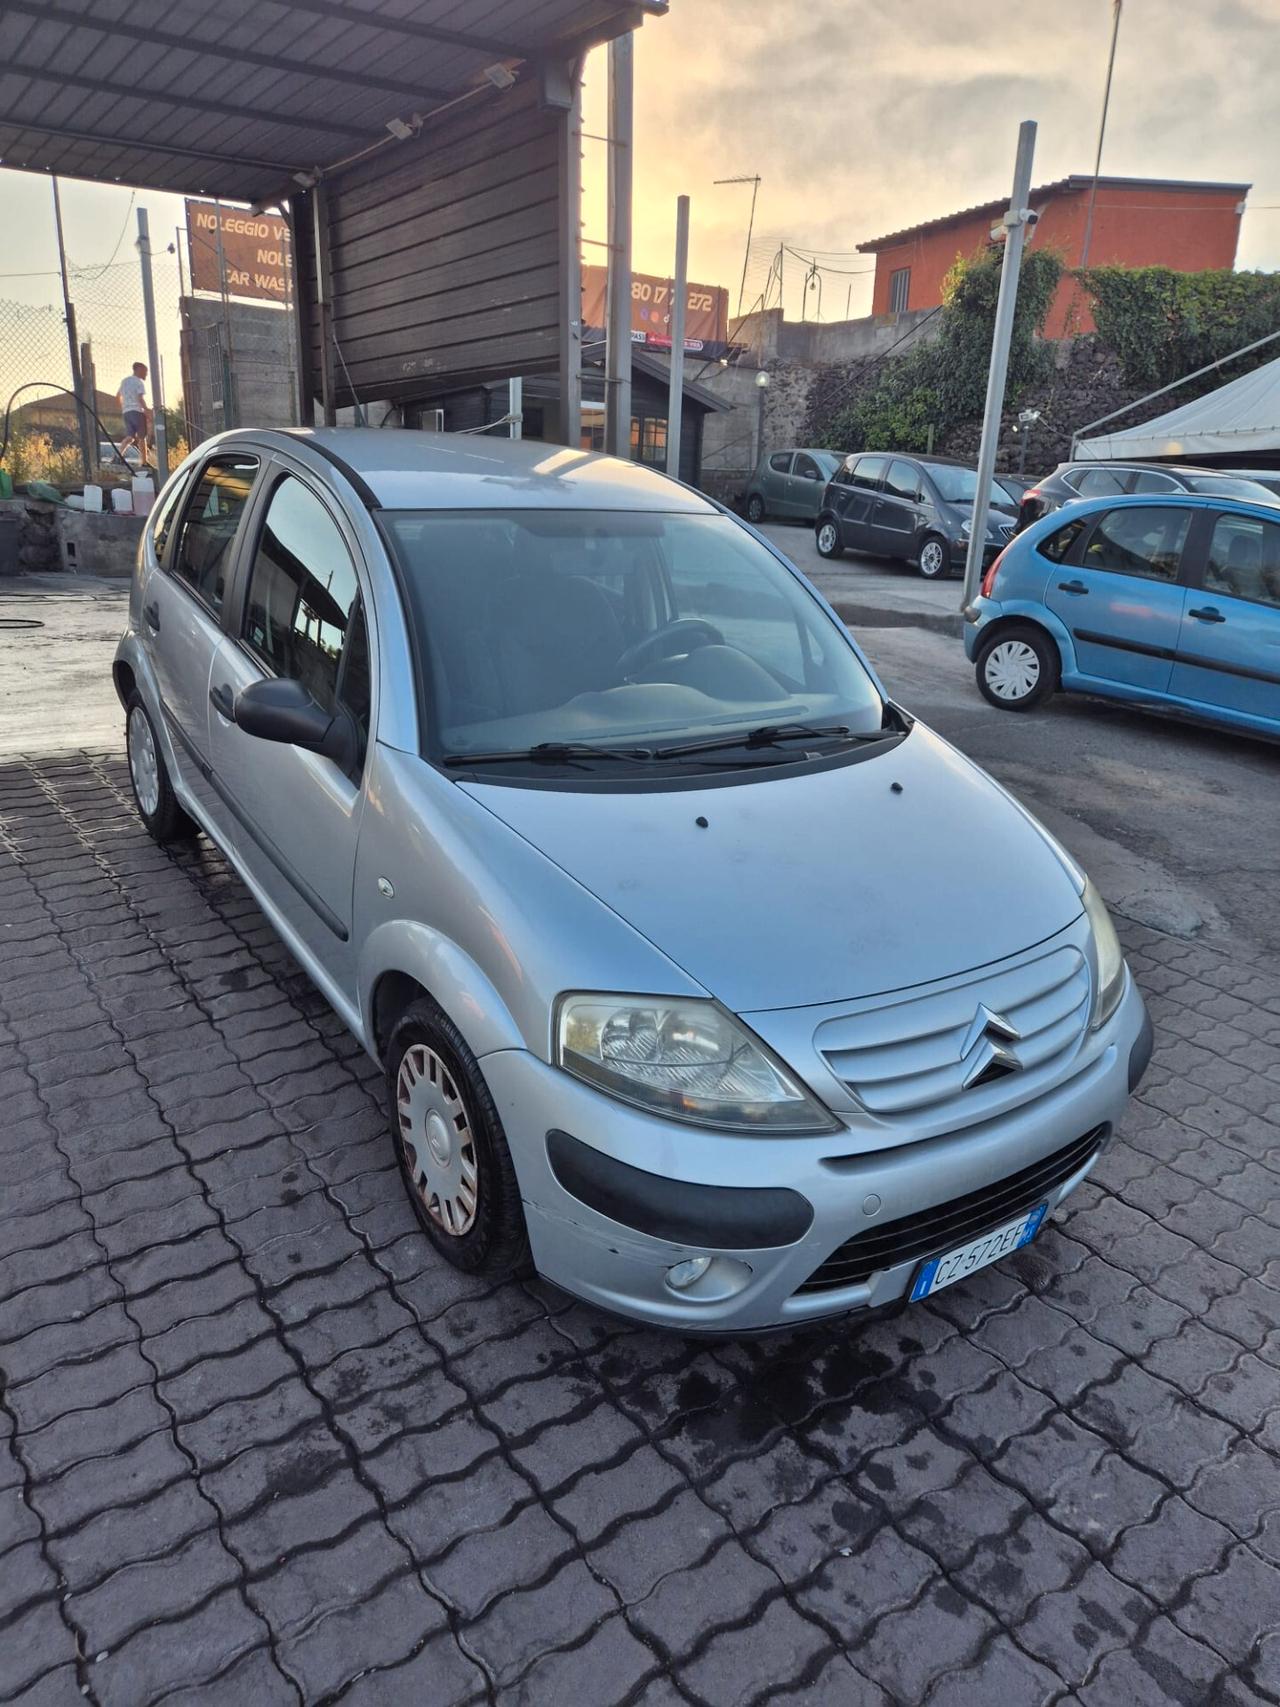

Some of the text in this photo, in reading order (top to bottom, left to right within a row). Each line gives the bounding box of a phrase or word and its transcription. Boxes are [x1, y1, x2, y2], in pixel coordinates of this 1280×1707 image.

[196, 213, 269, 238] NOLEGGIO
[257, 248, 292, 267] NOLE
[631, 281, 651, 301] 80
[687, 292, 713, 312] 272
